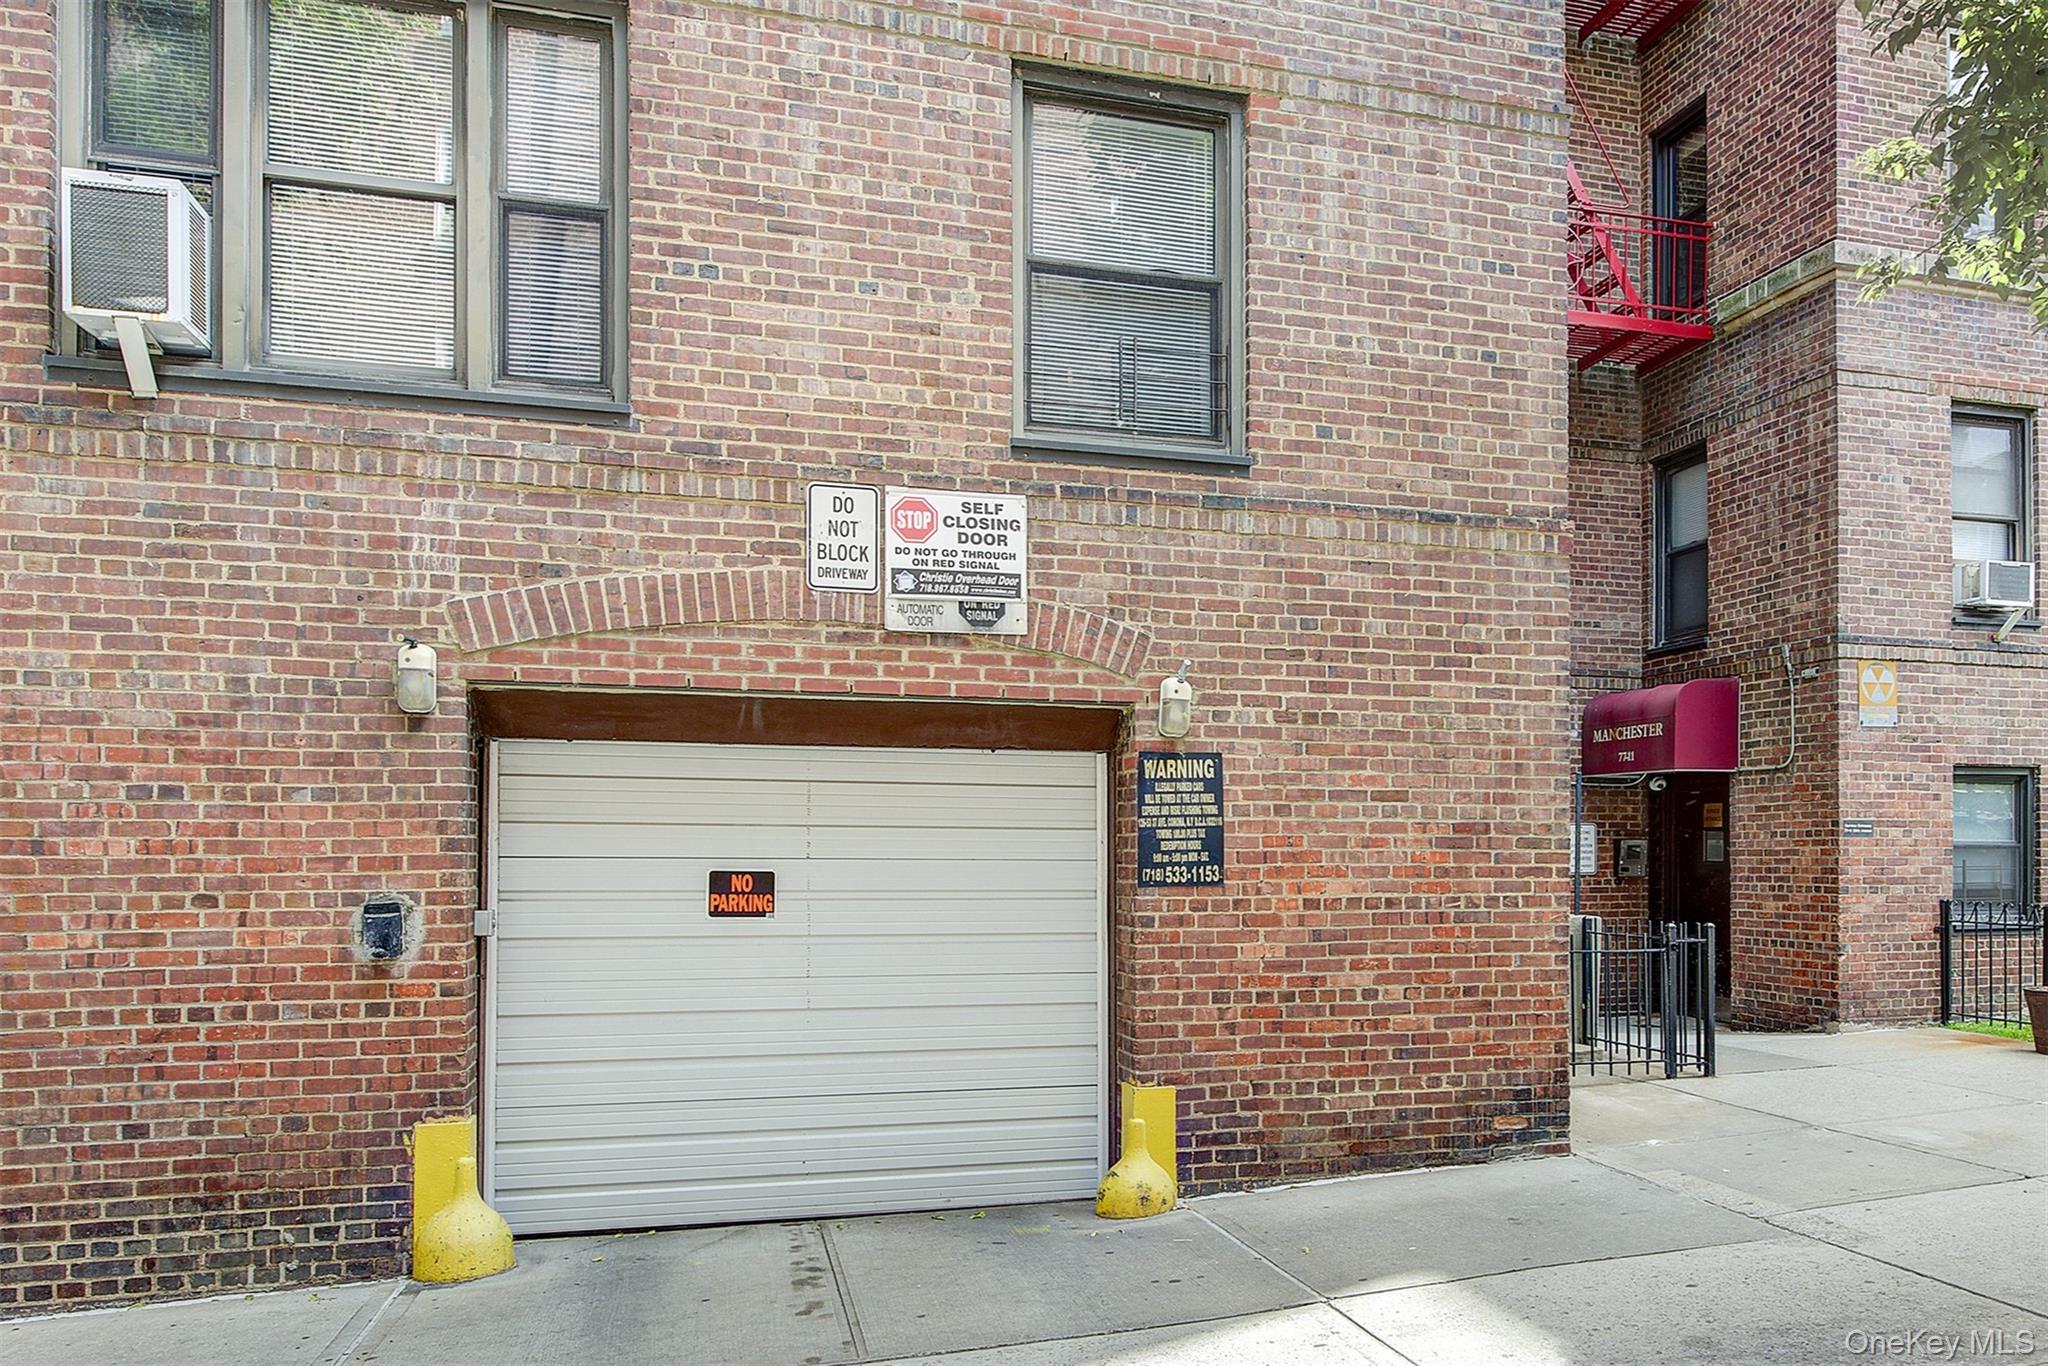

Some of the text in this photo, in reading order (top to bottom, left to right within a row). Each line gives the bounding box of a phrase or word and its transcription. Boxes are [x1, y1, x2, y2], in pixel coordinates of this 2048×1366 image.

[833, 496, 854, 513] DO
[961, 502, 1004, 515] SELF
[897, 510, 931, 529] STOP
[943, 516, 1020, 532] CLOSING
[828, 520, 858, 537] NOT
[958, 532, 1008, 546] DOOR
[817, 543, 869, 562] BLOCK
[895, 547, 1016, 560] DO NOT GO THROUGH
[912, 558, 1000, 570] ON RED SIGNAL
[818, 567, 868, 580] DRIVEWAY
[920, 572, 1019, 586] Christie Overhead Door
[897, 603, 944, 615] AUTOMATIC
[967, 610, 998, 621] SIGNAL
[908, 616, 933, 626] DOOR
[1593, 722, 1663, 743] MANCHESTER
[1144, 759, 1214, 778] WARNING
[1176, 782, 1192, 791] PARKED
[1193, 782, 1204, 791] CARS
[1144, 794, 1154, 803] WILL
[1155, 794, 1161, 803] BE
[1161, 794, 1175, 803] TOWED
[1182, 794, 1190, 803] THE
[1191, 793, 1199, 803] CAR
[1142, 806, 1160, 815] EXPENSE
[1161, 806, 1169, 815] AND
[1202, 805, 1218, 814] TOWING
[1156, 829, 1172, 838] TOWING
[1160, 840, 1201, 850] REDEMPTION HOURS
[1143, 865, 1219, 883] (718) 533-1153
[731, 874, 753, 892] NO
[710, 894, 773, 912] PARKING
